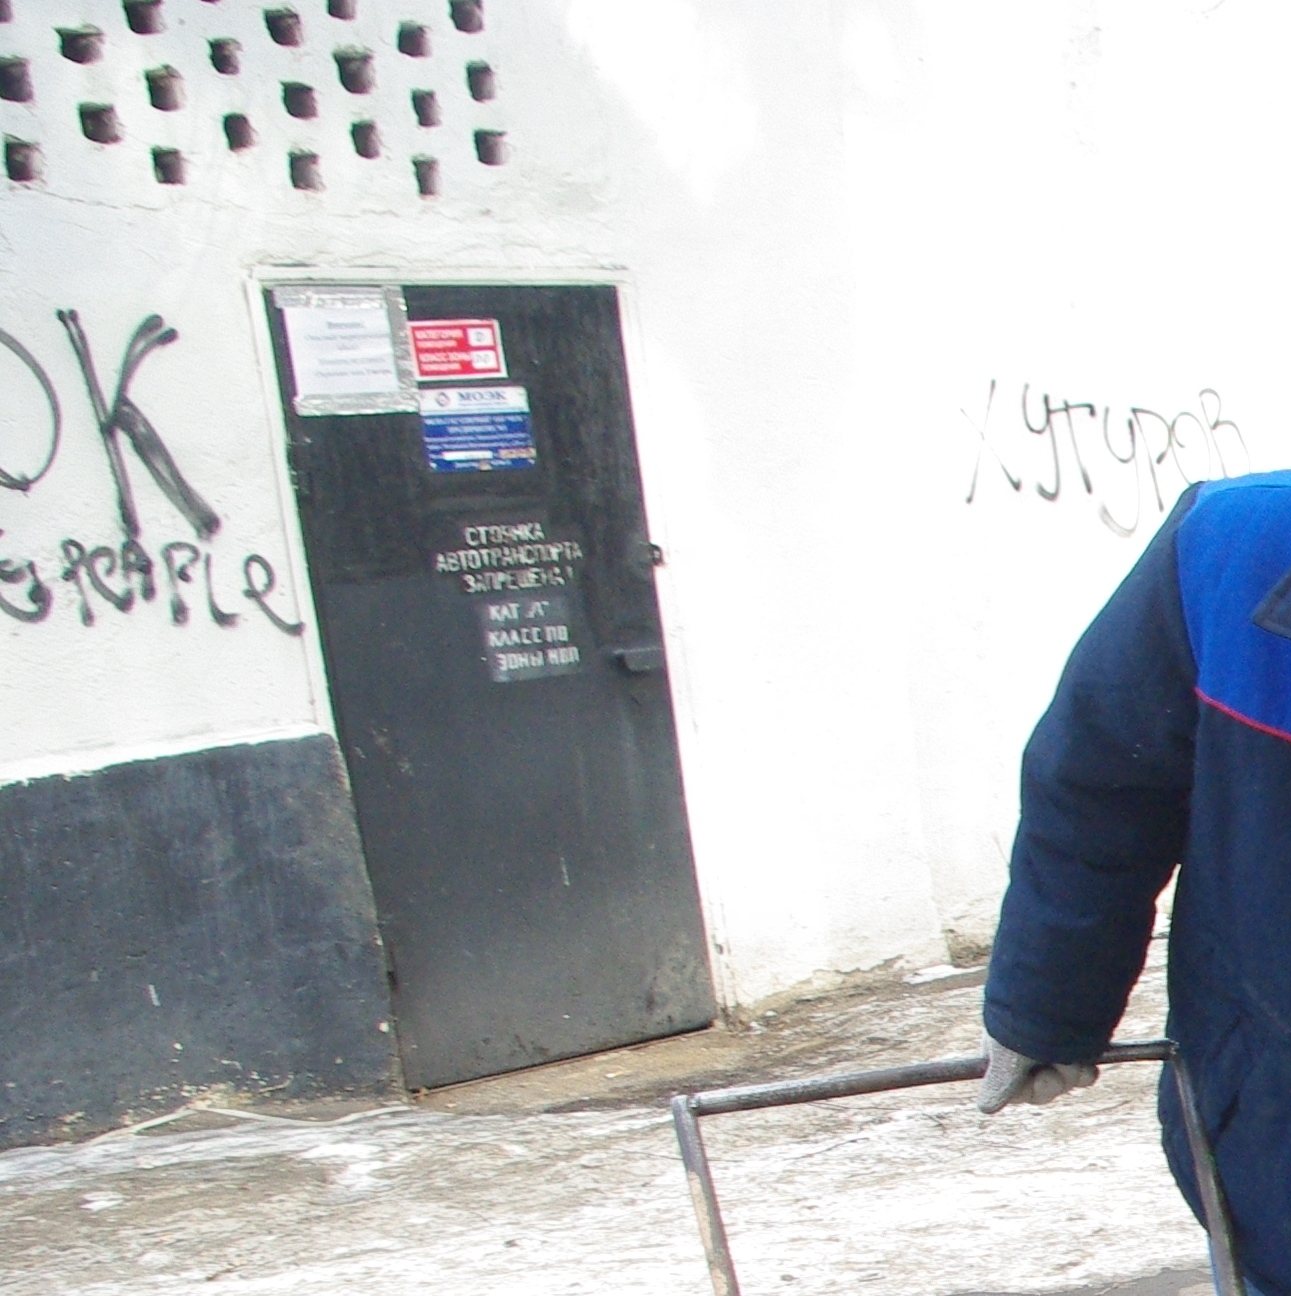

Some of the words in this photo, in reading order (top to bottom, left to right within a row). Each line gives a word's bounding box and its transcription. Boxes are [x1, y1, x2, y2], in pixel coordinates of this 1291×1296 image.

[457, 391, 508, 401] МОЭК
[464, 522, 545, 546] СТОЯНКА
[435, 541, 584, 573] АВТОТРАНСПОРТА
[487, 626, 542, 647] КЛАСС
